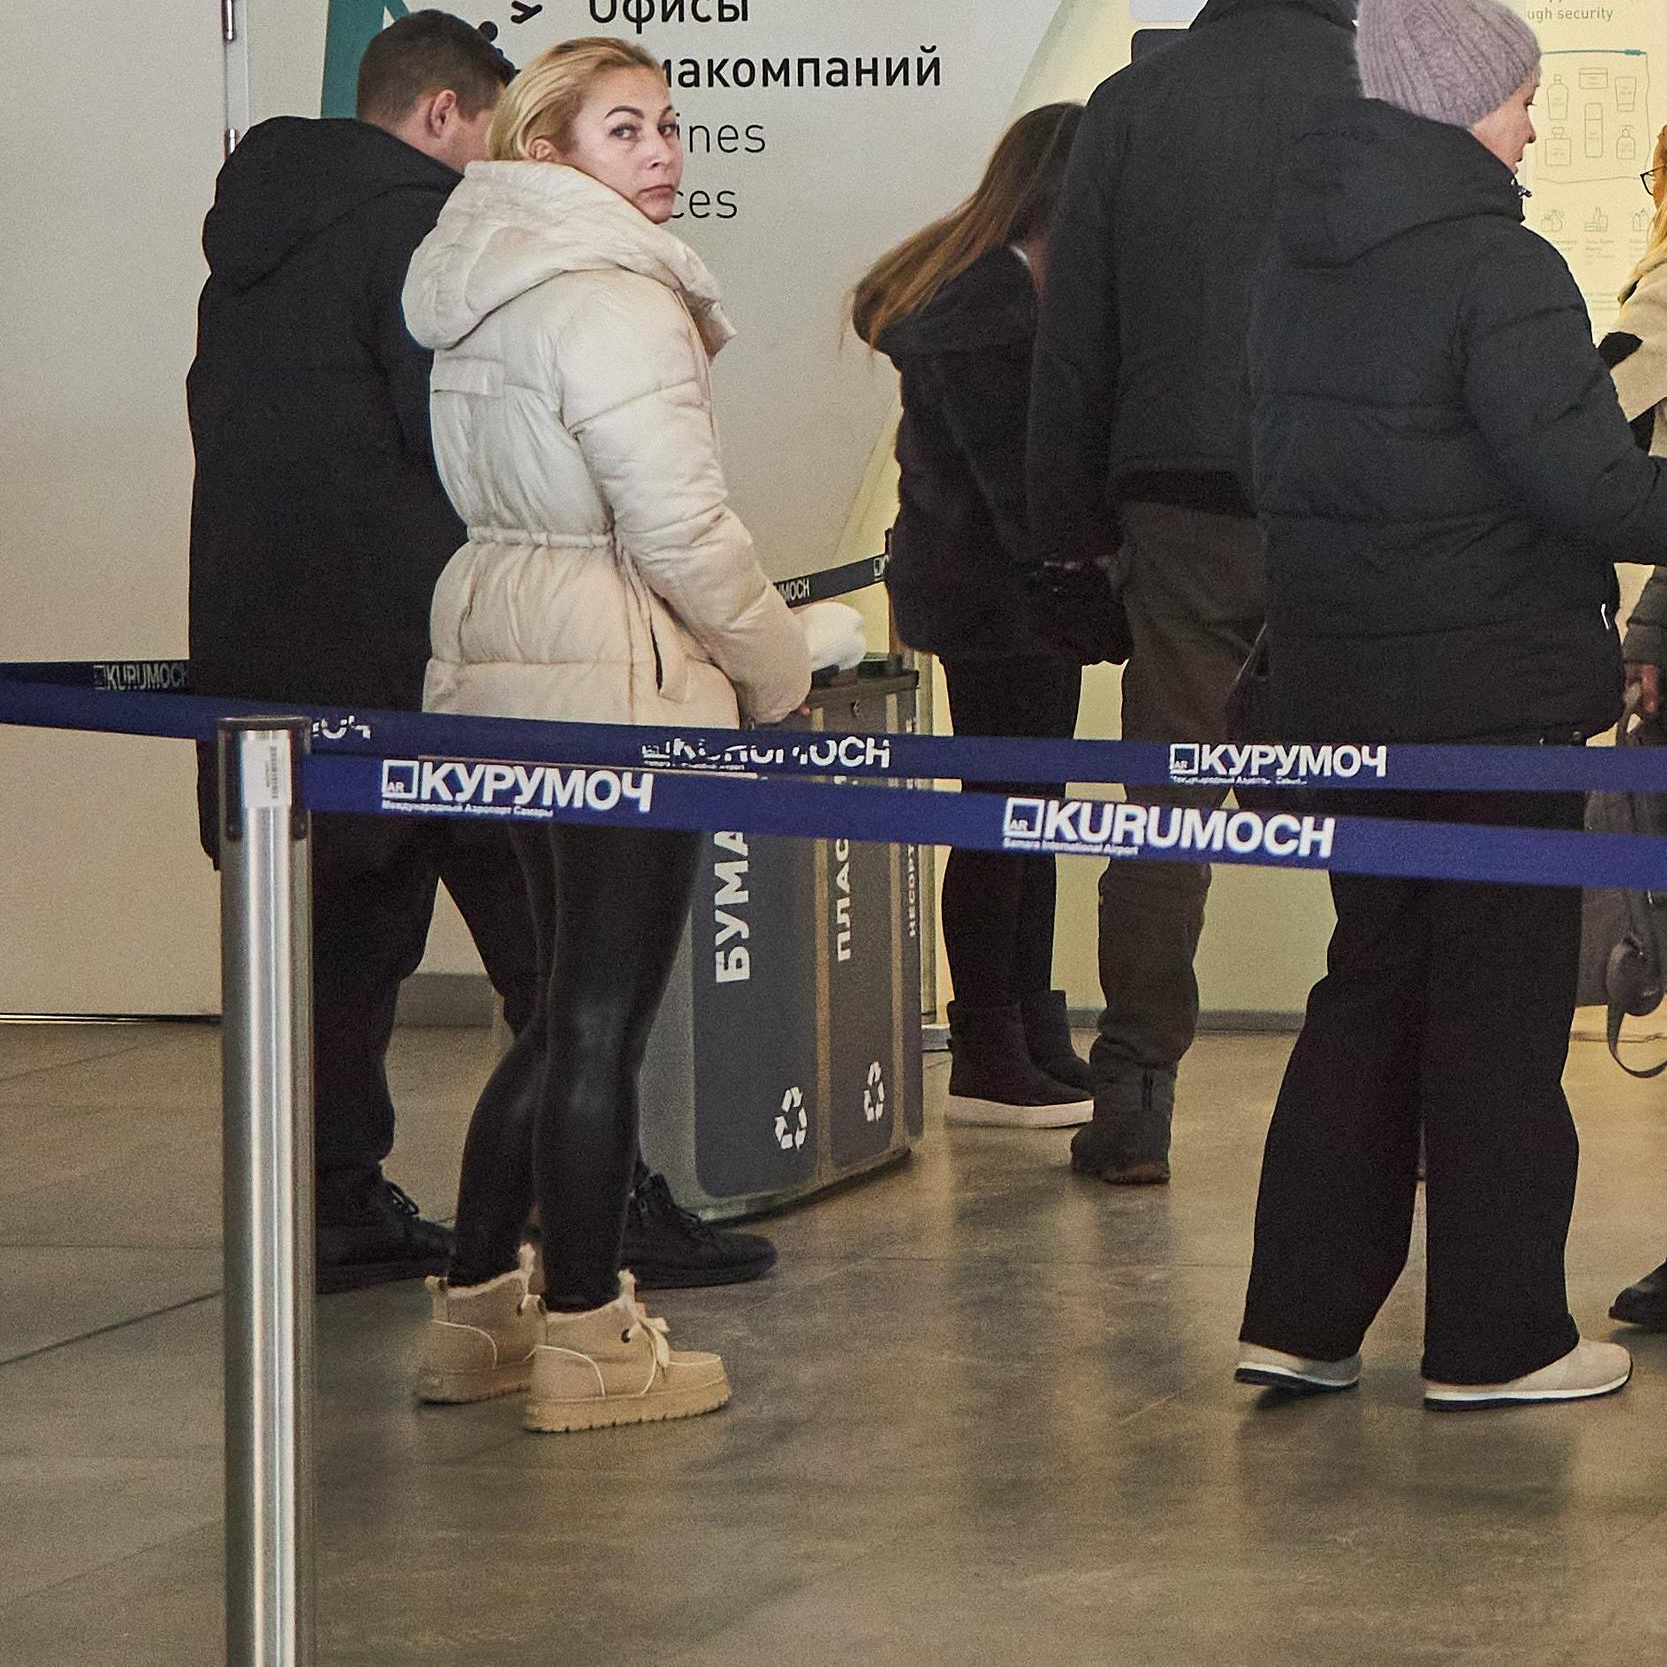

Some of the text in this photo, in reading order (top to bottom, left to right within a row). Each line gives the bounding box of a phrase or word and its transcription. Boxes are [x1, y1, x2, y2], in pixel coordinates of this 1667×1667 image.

[1558, 8, 1613, 22] security
[664, 45, 941, 87] акомпаний
[676, 112, 766, 153] ines
[1201, 743, 1388, 778] КУРУМОЧ
[419, 761, 654, 813] КУРУМОЧ
[1043, 798, 1335, 858] KURUMOCH
[714, 830, 751, 983] БУМА
[836, 838, 852, 962] ПЛАС
